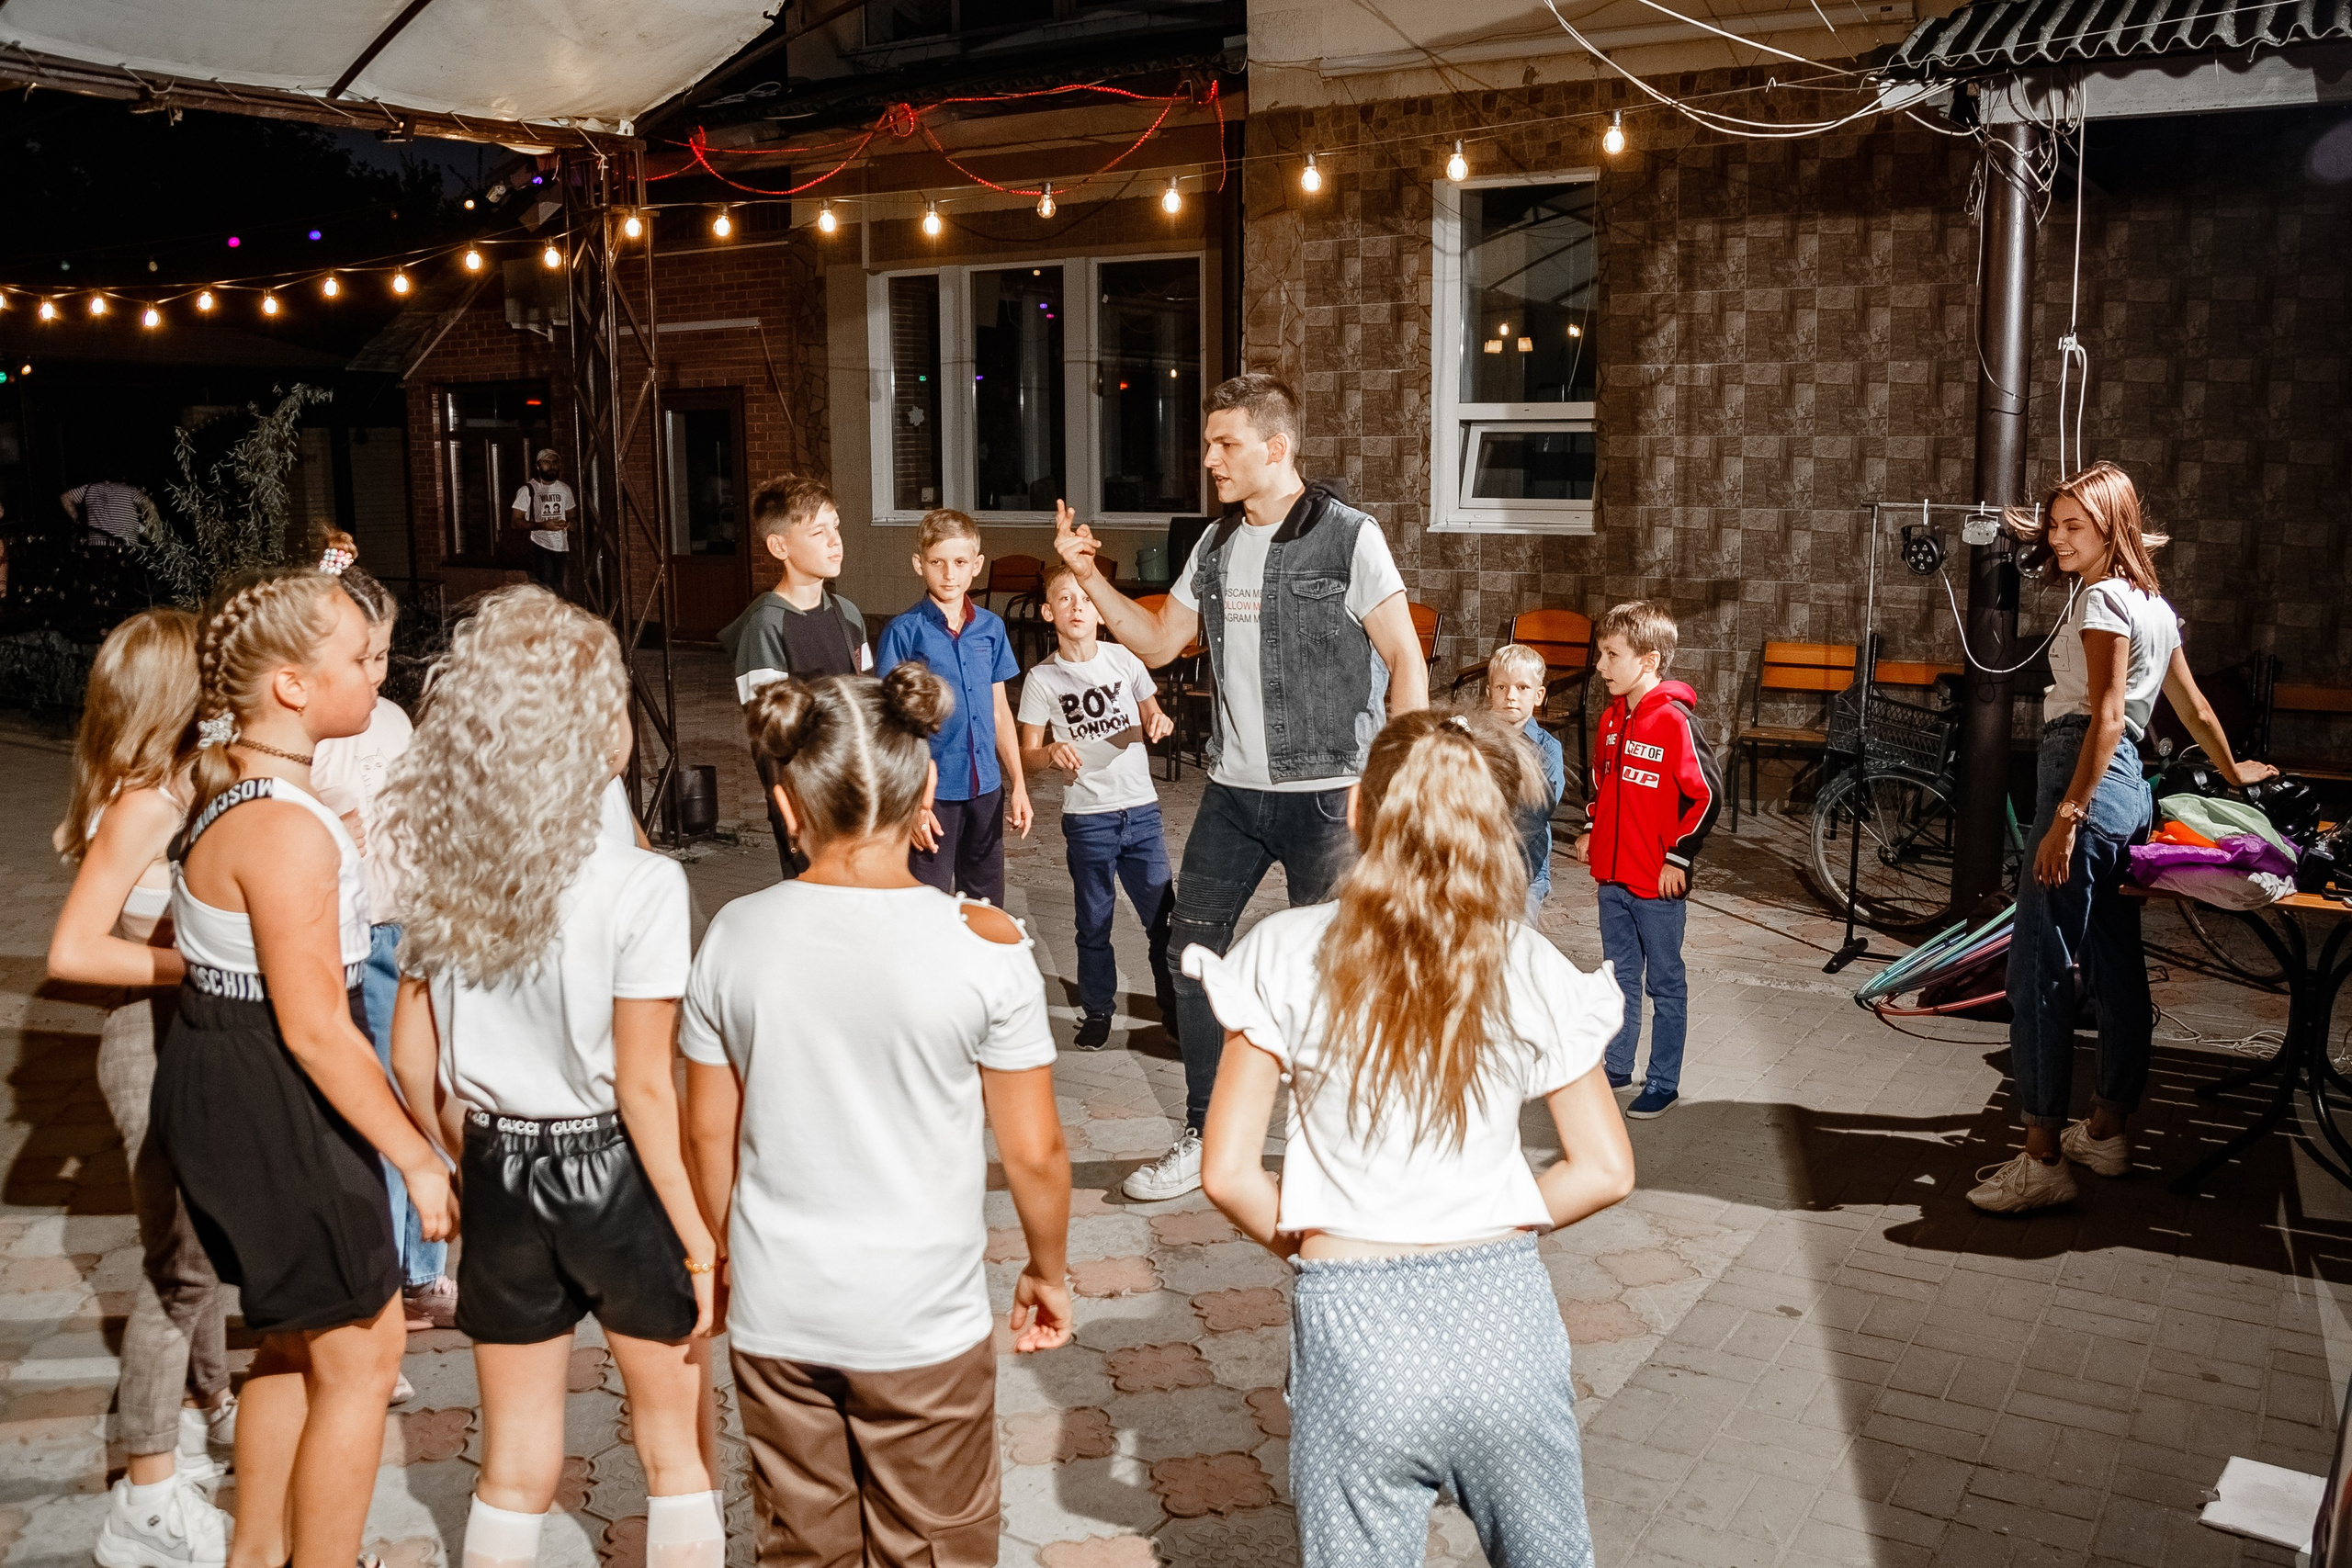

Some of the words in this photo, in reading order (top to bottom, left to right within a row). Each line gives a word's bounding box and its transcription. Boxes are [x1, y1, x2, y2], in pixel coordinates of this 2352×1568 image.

[539, 494, 561, 502] WANTED
[1058, 681, 1122, 725] BOY
[1068, 714, 1131, 741] LONDON
[1647, 747, 1662, 760] OF
[1623, 769, 1657, 784] UP
[497, 1117, 539, 1136] GUCCI
[550, 1117, 598, 1136] GUCCI
